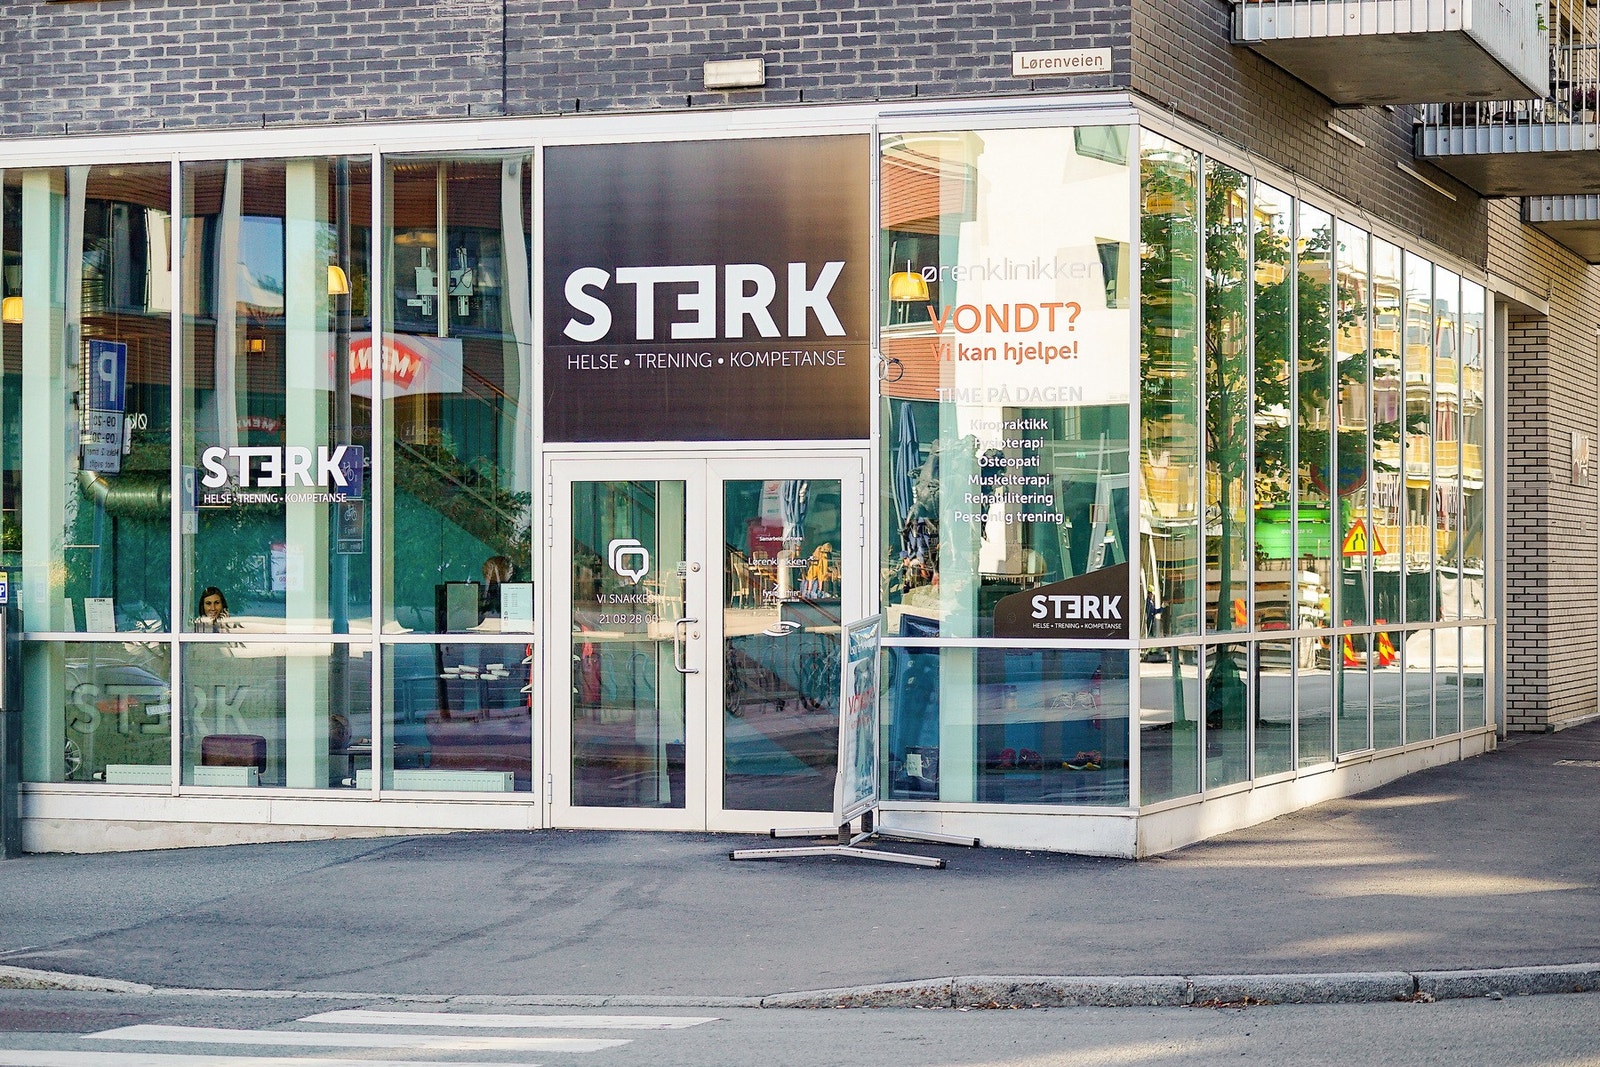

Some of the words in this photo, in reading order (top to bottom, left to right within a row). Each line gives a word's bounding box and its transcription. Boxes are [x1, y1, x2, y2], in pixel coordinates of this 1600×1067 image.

[1021, 53, 1103, 69] Lørenveien
[563, 261, 847, 343] STERK
[926, 301, 1082, 334] VONDT?
[567, 353, 619, 370] HELSE
[635, 352, 712, 369] TRENING
[729, 350, 846, 368] KOMPETANSE
[930, 343, 951, 362] Vi
[958, 343, 996, 361] kan
[1004, 341, 1078, 365] hjelpe!
[935, 387, 981, 404] TIME
[987, 384, 1008, 402] PÅ
[1016, 386, 1083, 402] DAGEN
[970, 418, 1048, 431] Kiropraktikk
[974, 437, 1044, 450] Fysioterapi
[202, 446, 348, 488] STERK
[977, 455, 1040, 469] Osteopati
[968, 474, 1050, 487] Muskelterapi
[203, 493, 232, 504] HELSE
[238, 493, 279, 503] TRENING
[284, 492, 347, 503] KOMPETANSE
[964, 492, 1053, 506] Rehabilitering
[1017, 511, 1063, 524] trening
[596, 594, 607, 604] VI
[1031, 594, 1123, 620] STERK
[599, 613, 610, 624] 21
[613, 613, 627, 624] 08
[629, 613, 642, 624] 28
[1084, 622, 1122, 630] KOMPETANSE
